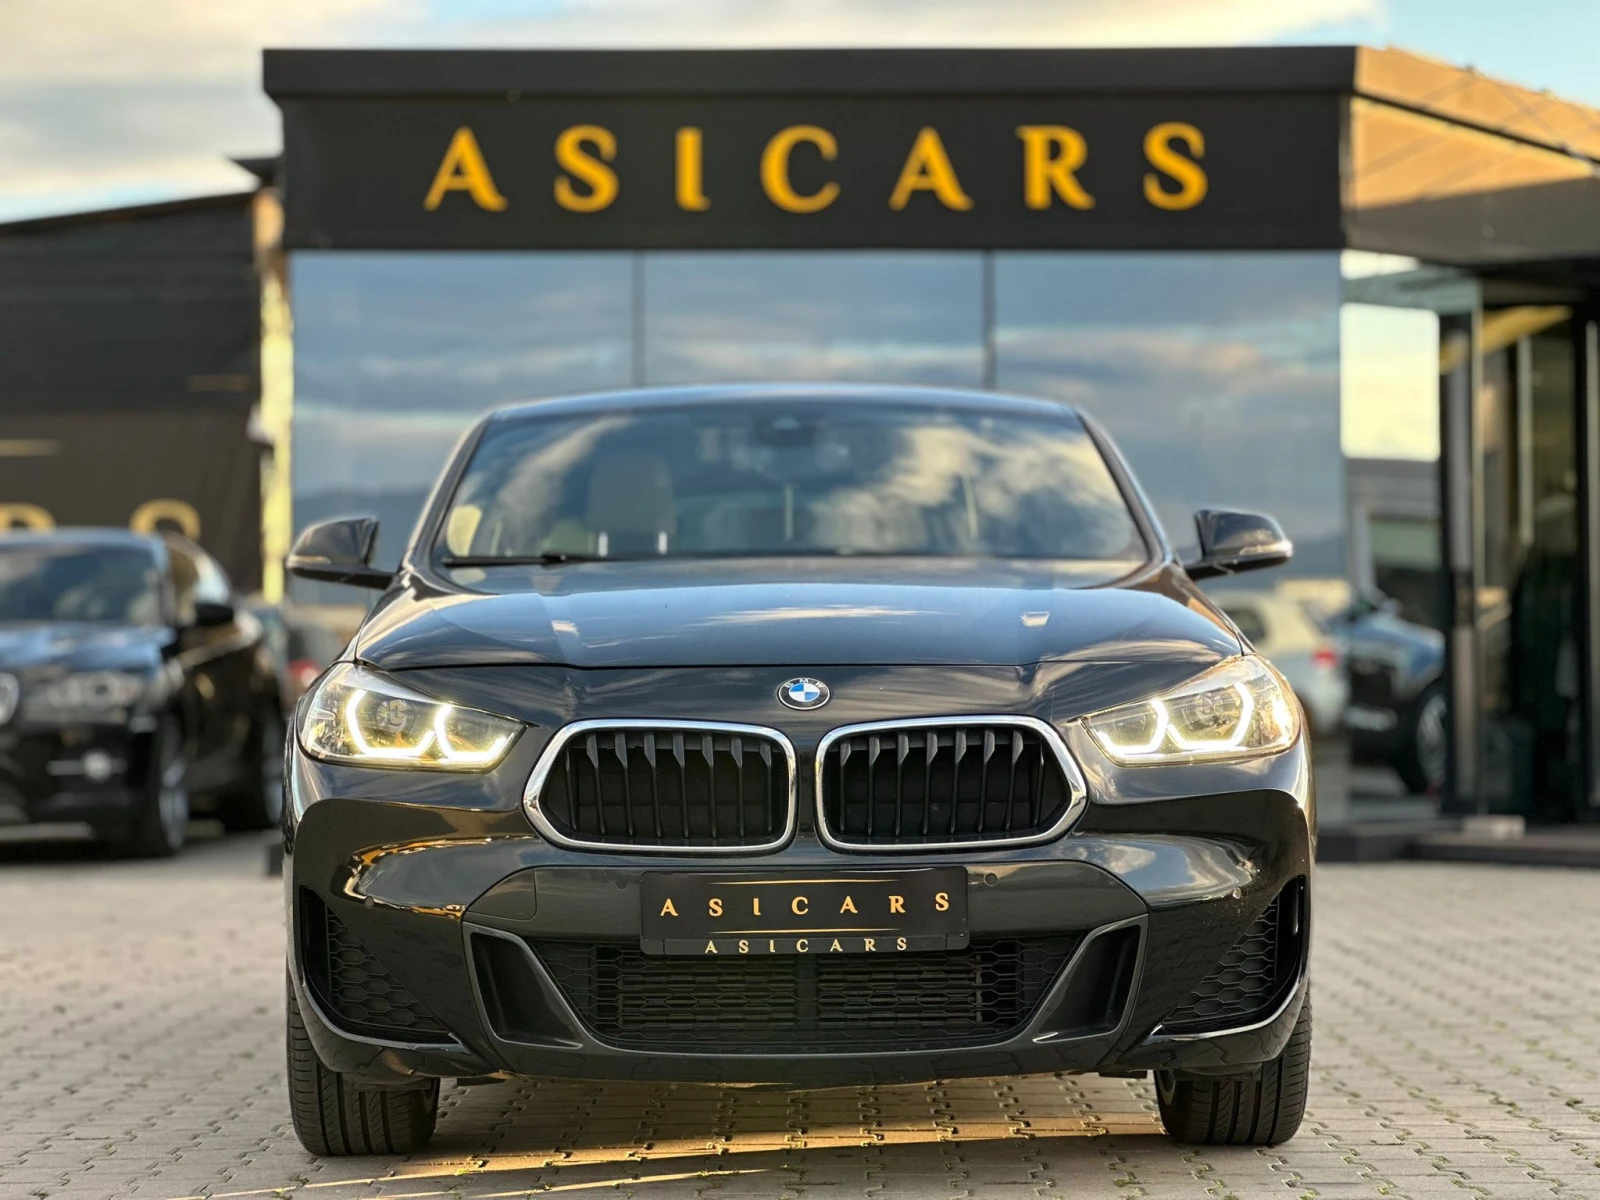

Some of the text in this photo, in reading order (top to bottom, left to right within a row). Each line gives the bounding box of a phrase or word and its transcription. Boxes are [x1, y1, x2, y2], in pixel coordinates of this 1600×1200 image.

[423, 122, 1209, 213] ASICARS
[784, 678, 825, 688] BMW
[660, 892, 950, 917] ASICARS
[705, 937, 907, 953] ASICARS
